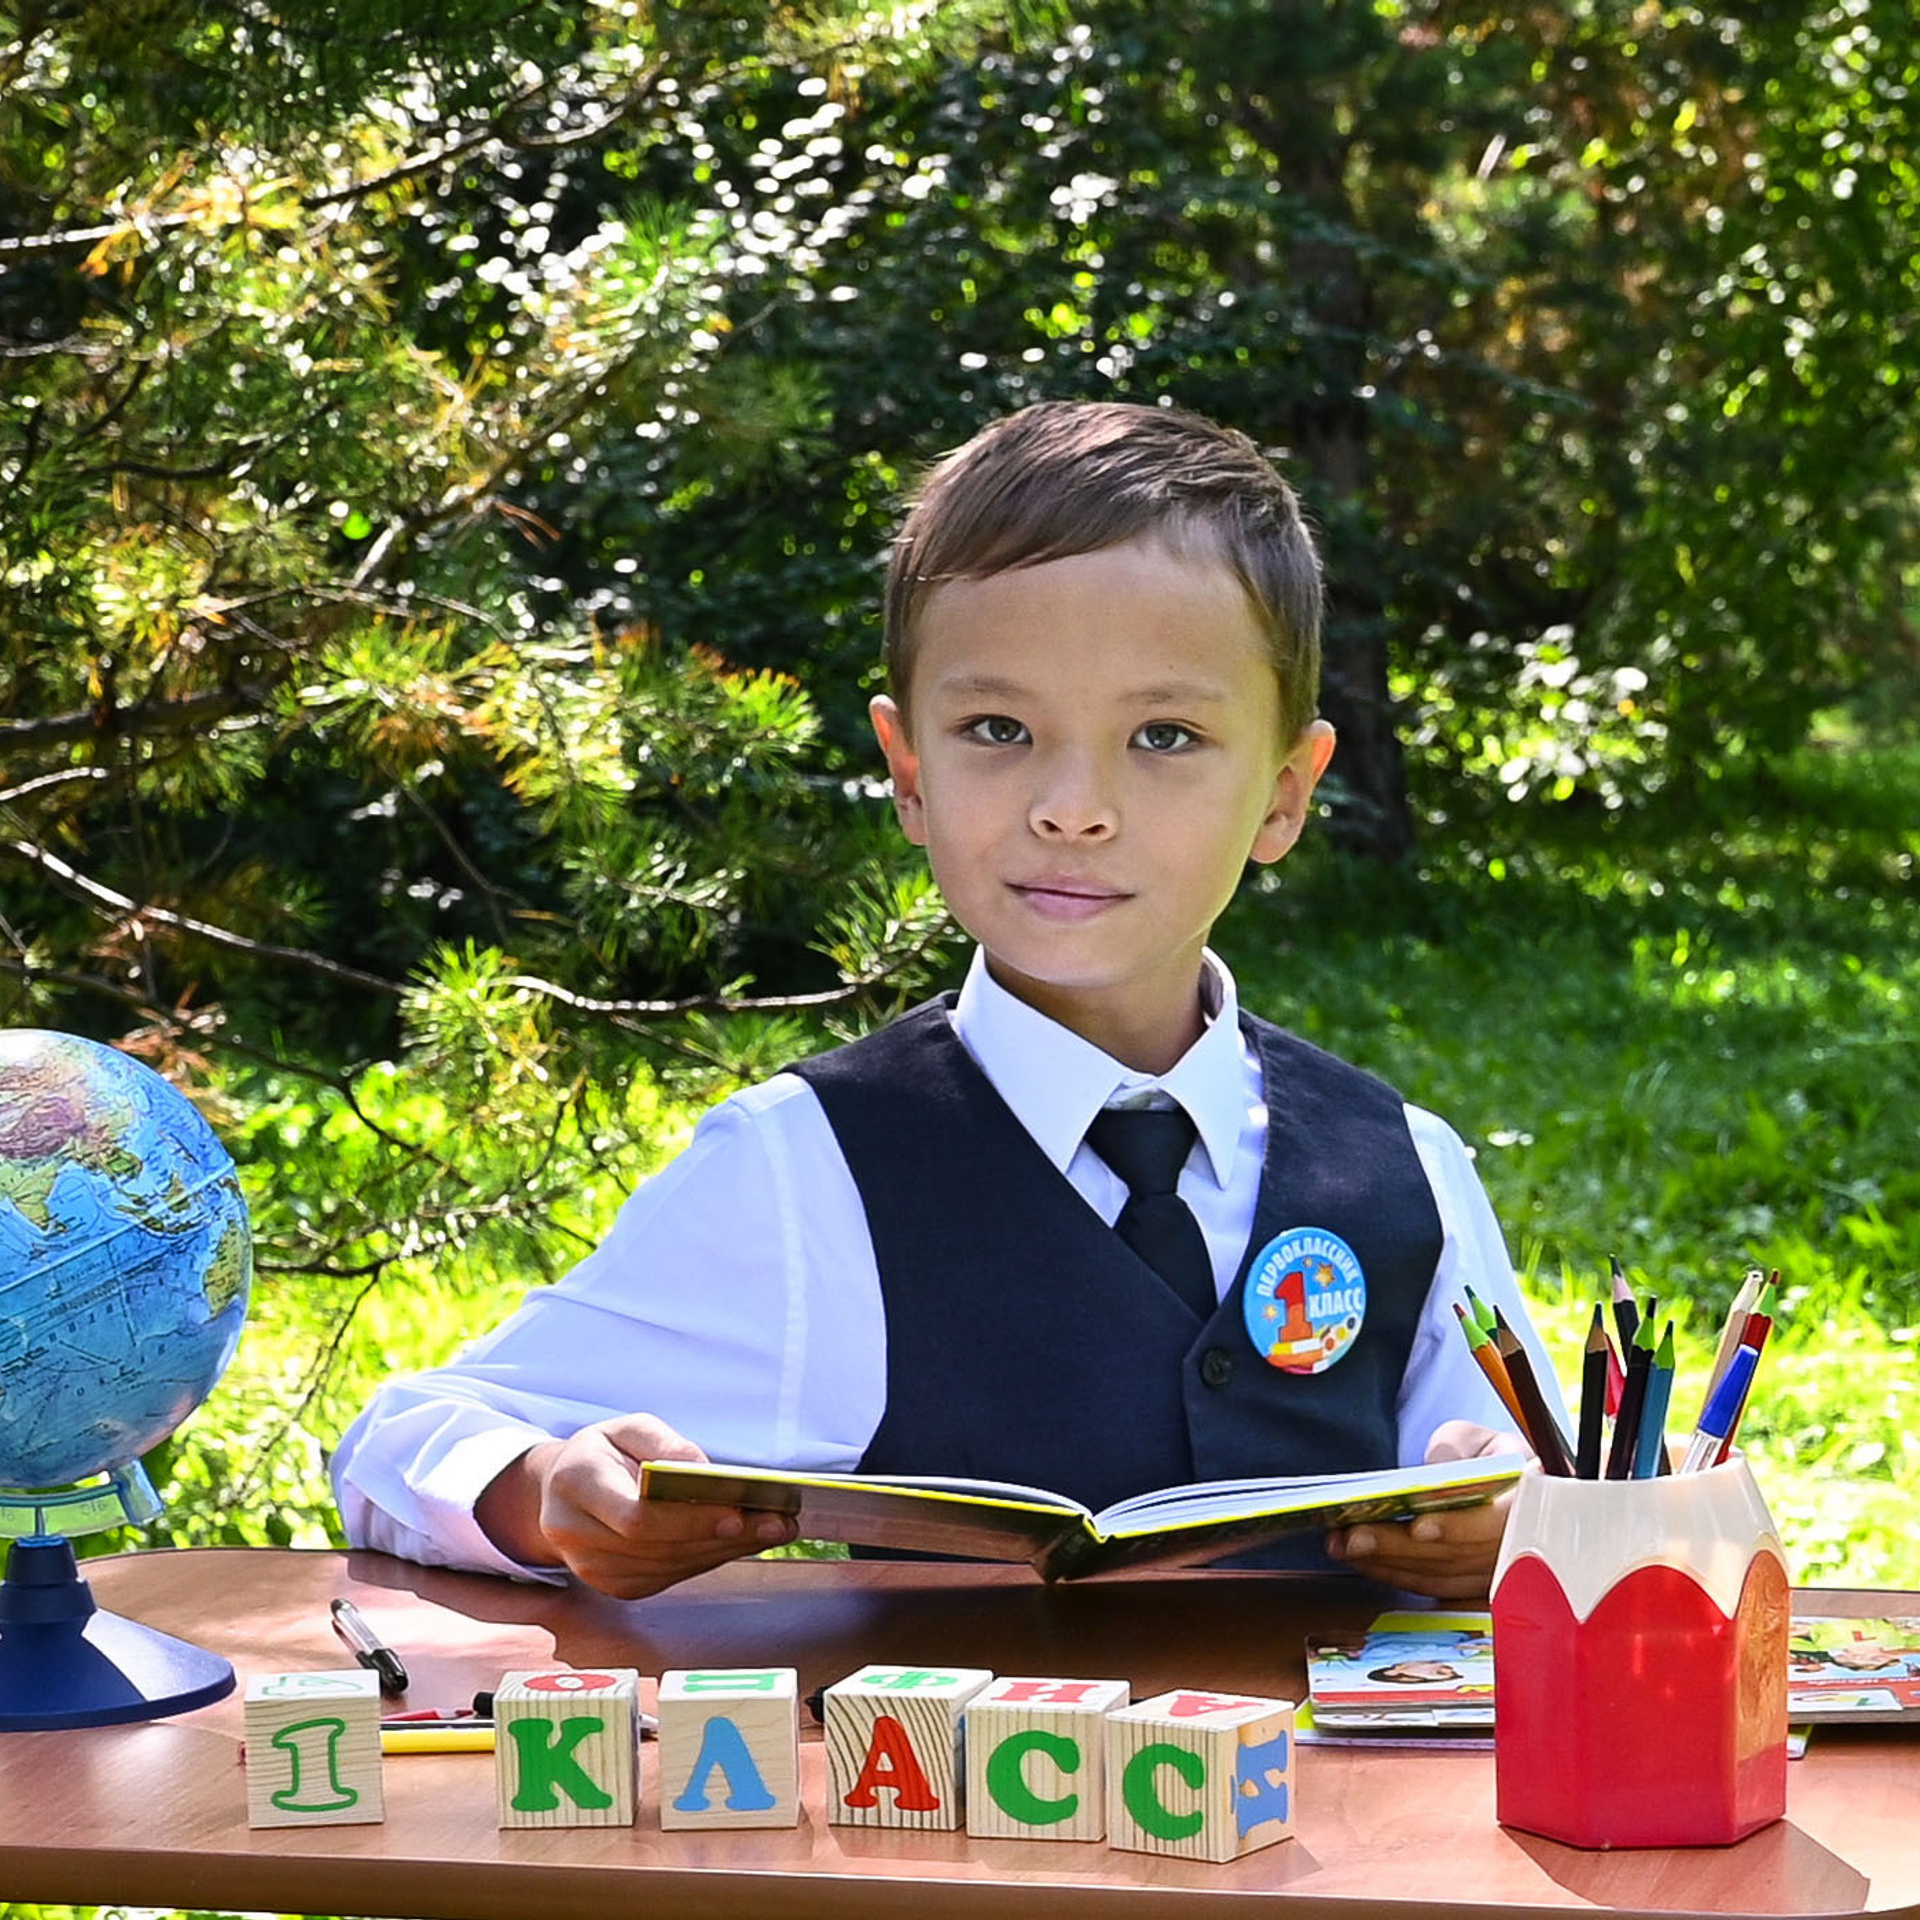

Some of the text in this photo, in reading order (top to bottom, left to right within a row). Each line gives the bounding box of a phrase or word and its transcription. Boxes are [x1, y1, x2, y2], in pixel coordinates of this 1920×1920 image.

[1256, 1237, 1359, 1296] ПЕРВОКЛАССНИК
[1274, 1271, 1362, 1343] 1 КЛАСС
[270, 1717, 358, 1812] 1
